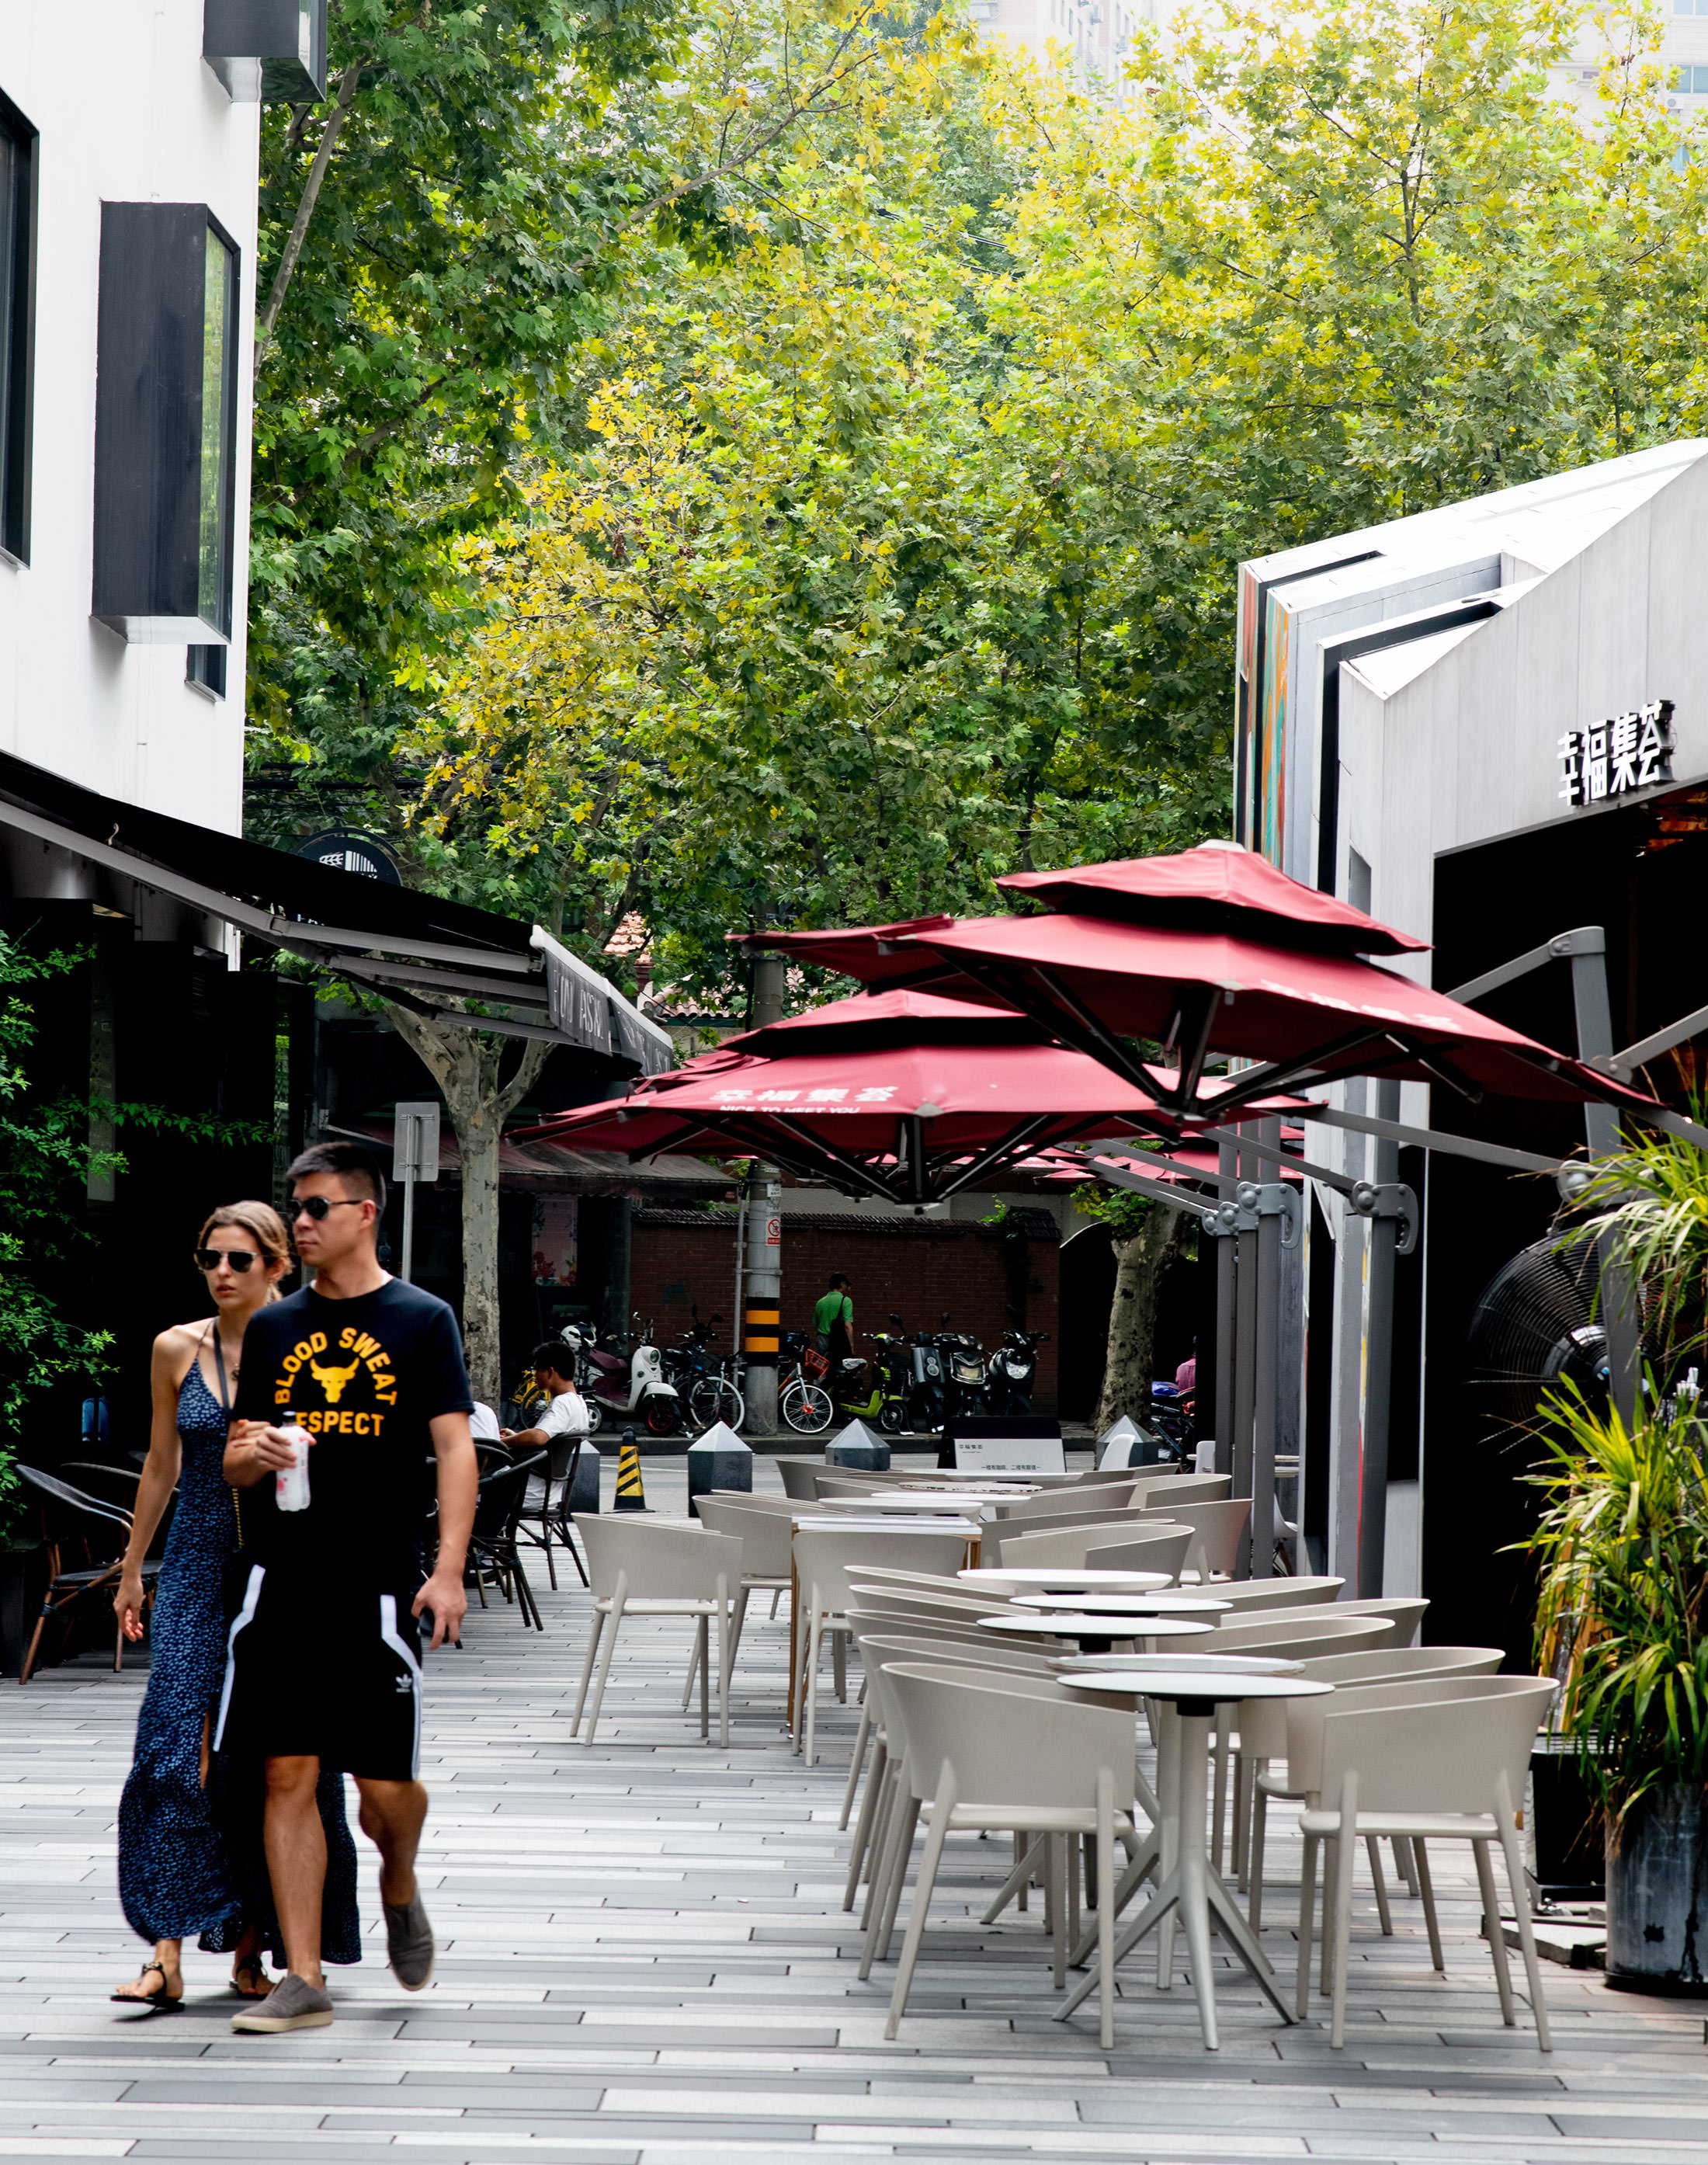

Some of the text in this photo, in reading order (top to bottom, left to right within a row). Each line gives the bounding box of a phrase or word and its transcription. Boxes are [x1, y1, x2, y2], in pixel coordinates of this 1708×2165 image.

[1557, 699, 1664, 806] 幸福集荟
[274, 1327, 397, 1406] BLOOD SWEAT
[296, 1410, 384, 1436] ESPECT
